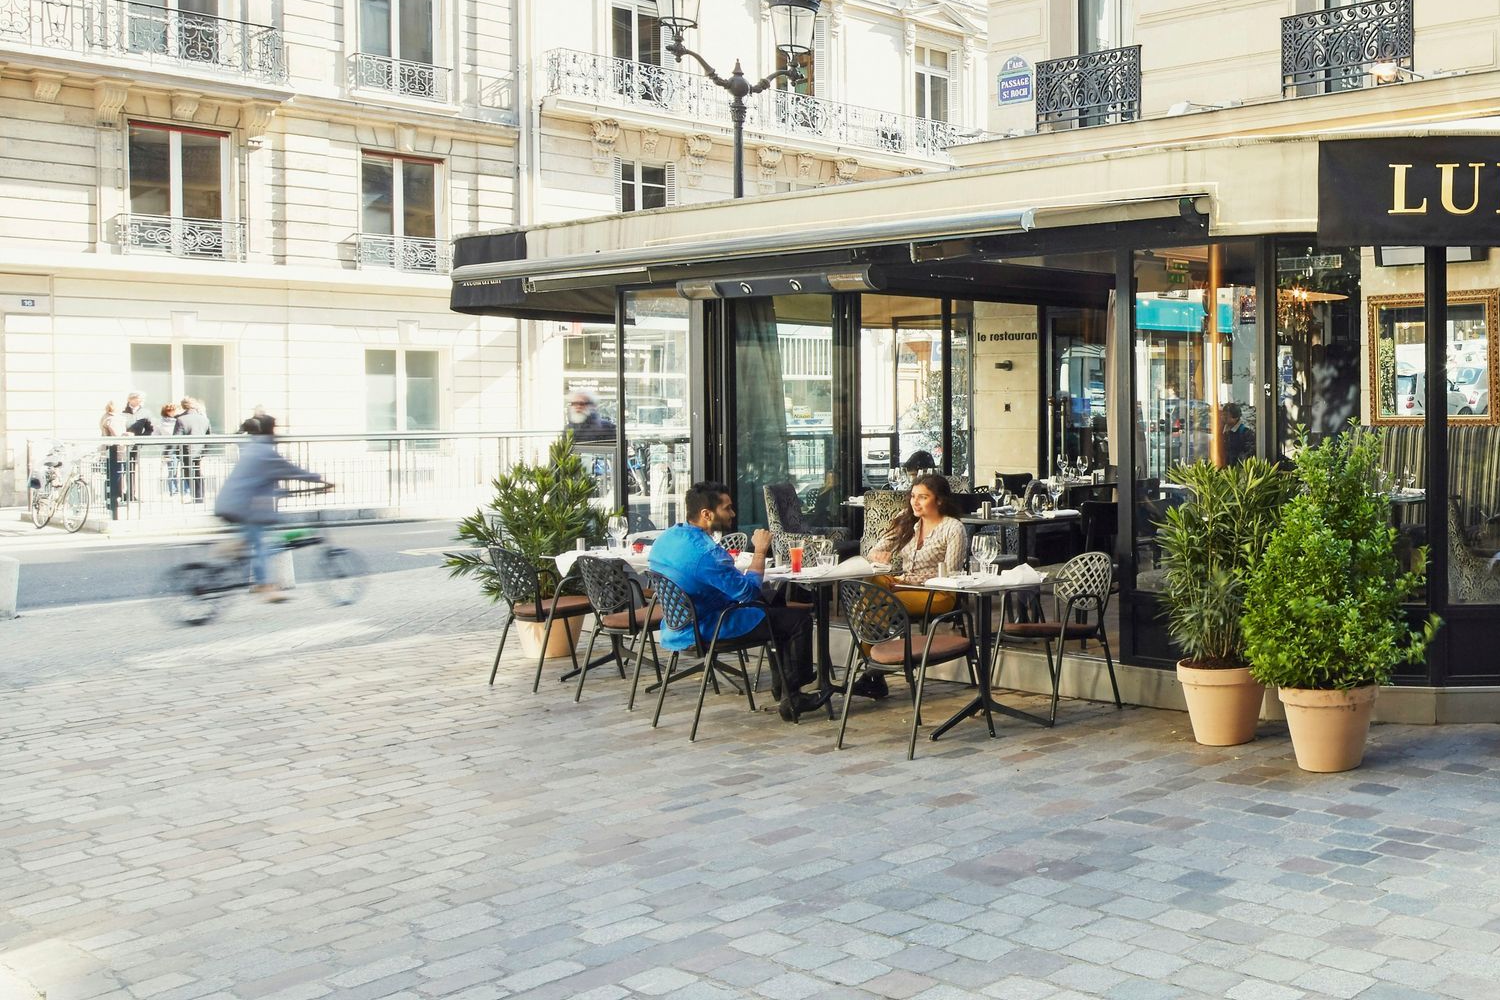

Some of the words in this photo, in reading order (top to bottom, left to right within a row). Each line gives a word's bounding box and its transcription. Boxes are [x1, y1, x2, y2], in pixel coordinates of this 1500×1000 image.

[1001, 77, 1030, 90] PASSAGE
[977, 332, 987, 342] le
[990, 331, 1038, 342] restauran
